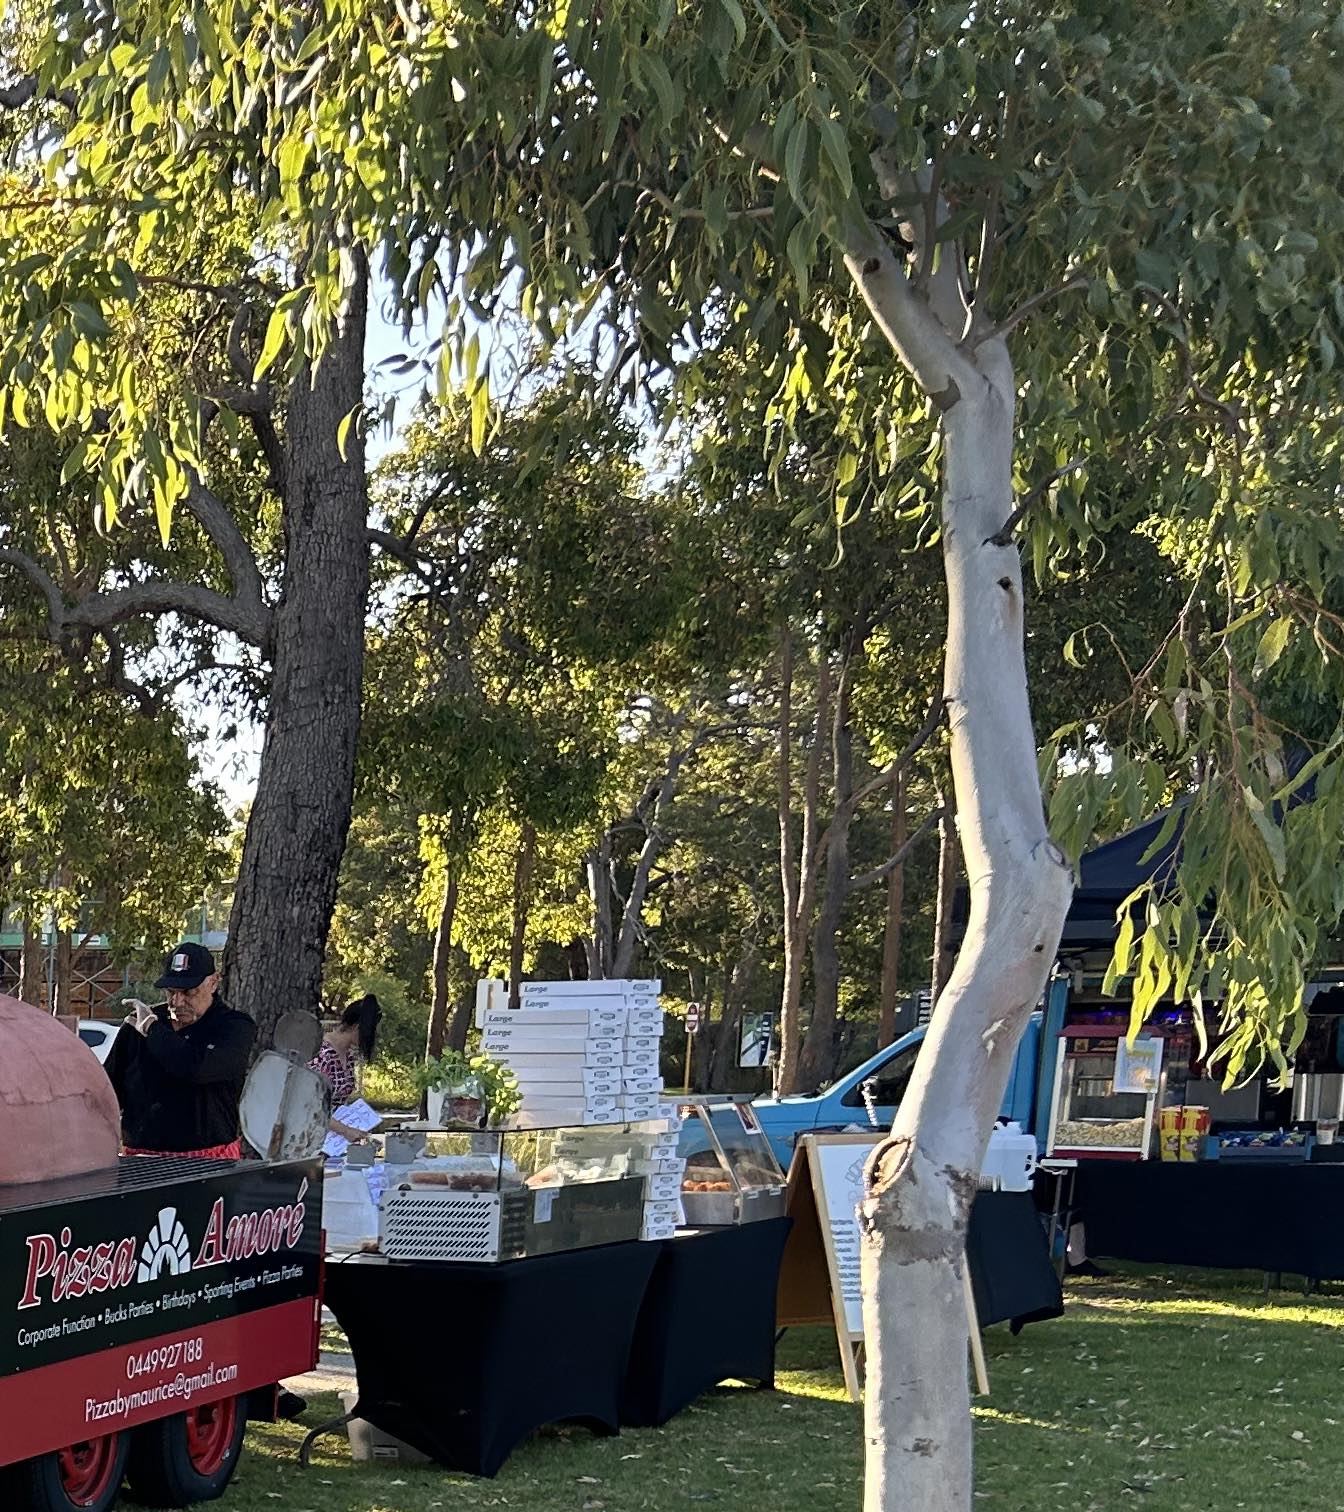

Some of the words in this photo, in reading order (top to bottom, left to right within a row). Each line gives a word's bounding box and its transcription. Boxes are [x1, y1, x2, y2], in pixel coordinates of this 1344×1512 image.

[17, 1226, 138, 1310] Pizza
[191, 1176, 309, 1270] Amoré
[18, 1323, 62, 1348] Corporate
[61, 1315, 96, 1335] Function
[104, 1303, 128, 1325] Bucks
[128, 1300, 154, 1319] Parties
[162, 1288, 197, 1311] Birthdays
[203, 1280, 233, 1304] Sporting
[234, 1275, 256, 1293] Events
[281, 1263, 304, 1281] Parties
[85, 1362, 238, 1423] Pizzabymaurice@gmail.com
[126, 1337, 204, 1380] 0449927188
